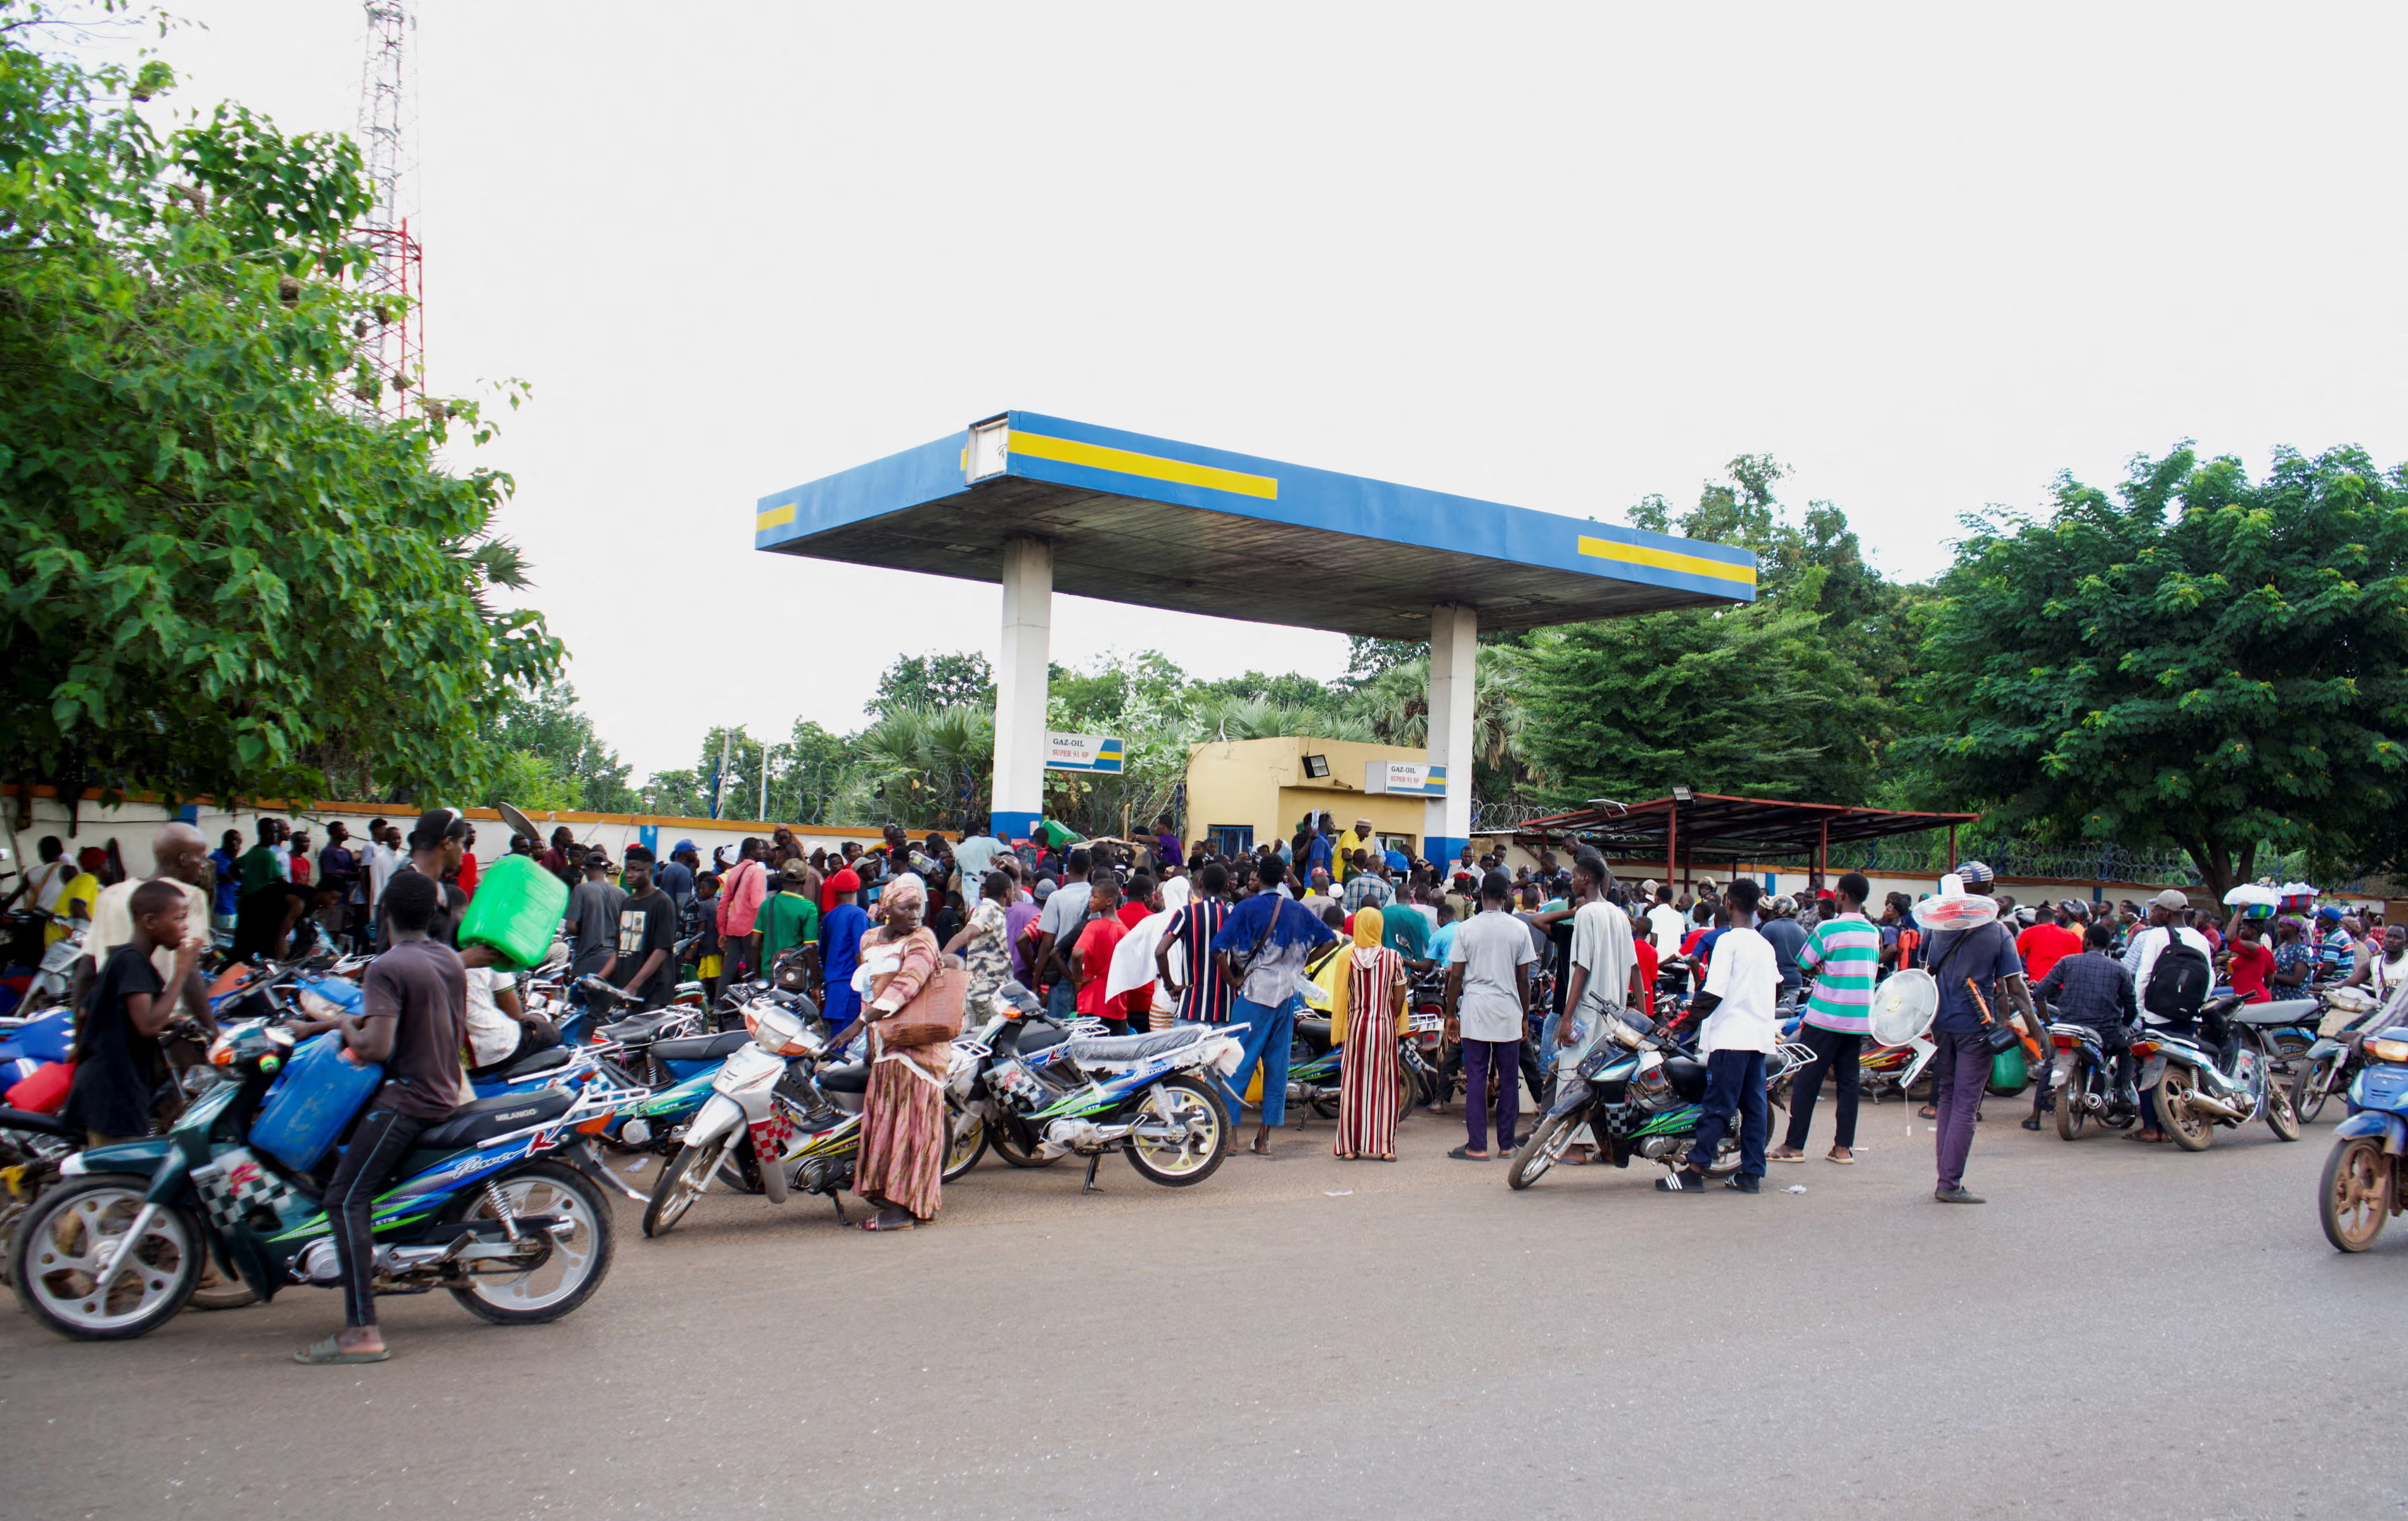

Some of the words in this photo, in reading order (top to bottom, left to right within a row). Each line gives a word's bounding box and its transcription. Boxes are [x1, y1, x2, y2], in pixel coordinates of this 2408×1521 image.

[1053, 738, 1085, 747] GAZ-OIL
[1052, 749, 1072, 757] SUPER
[1391, 766, 1416, 774] GAZ-OIL
[494, 1108, 538, 1122] MILANGO
